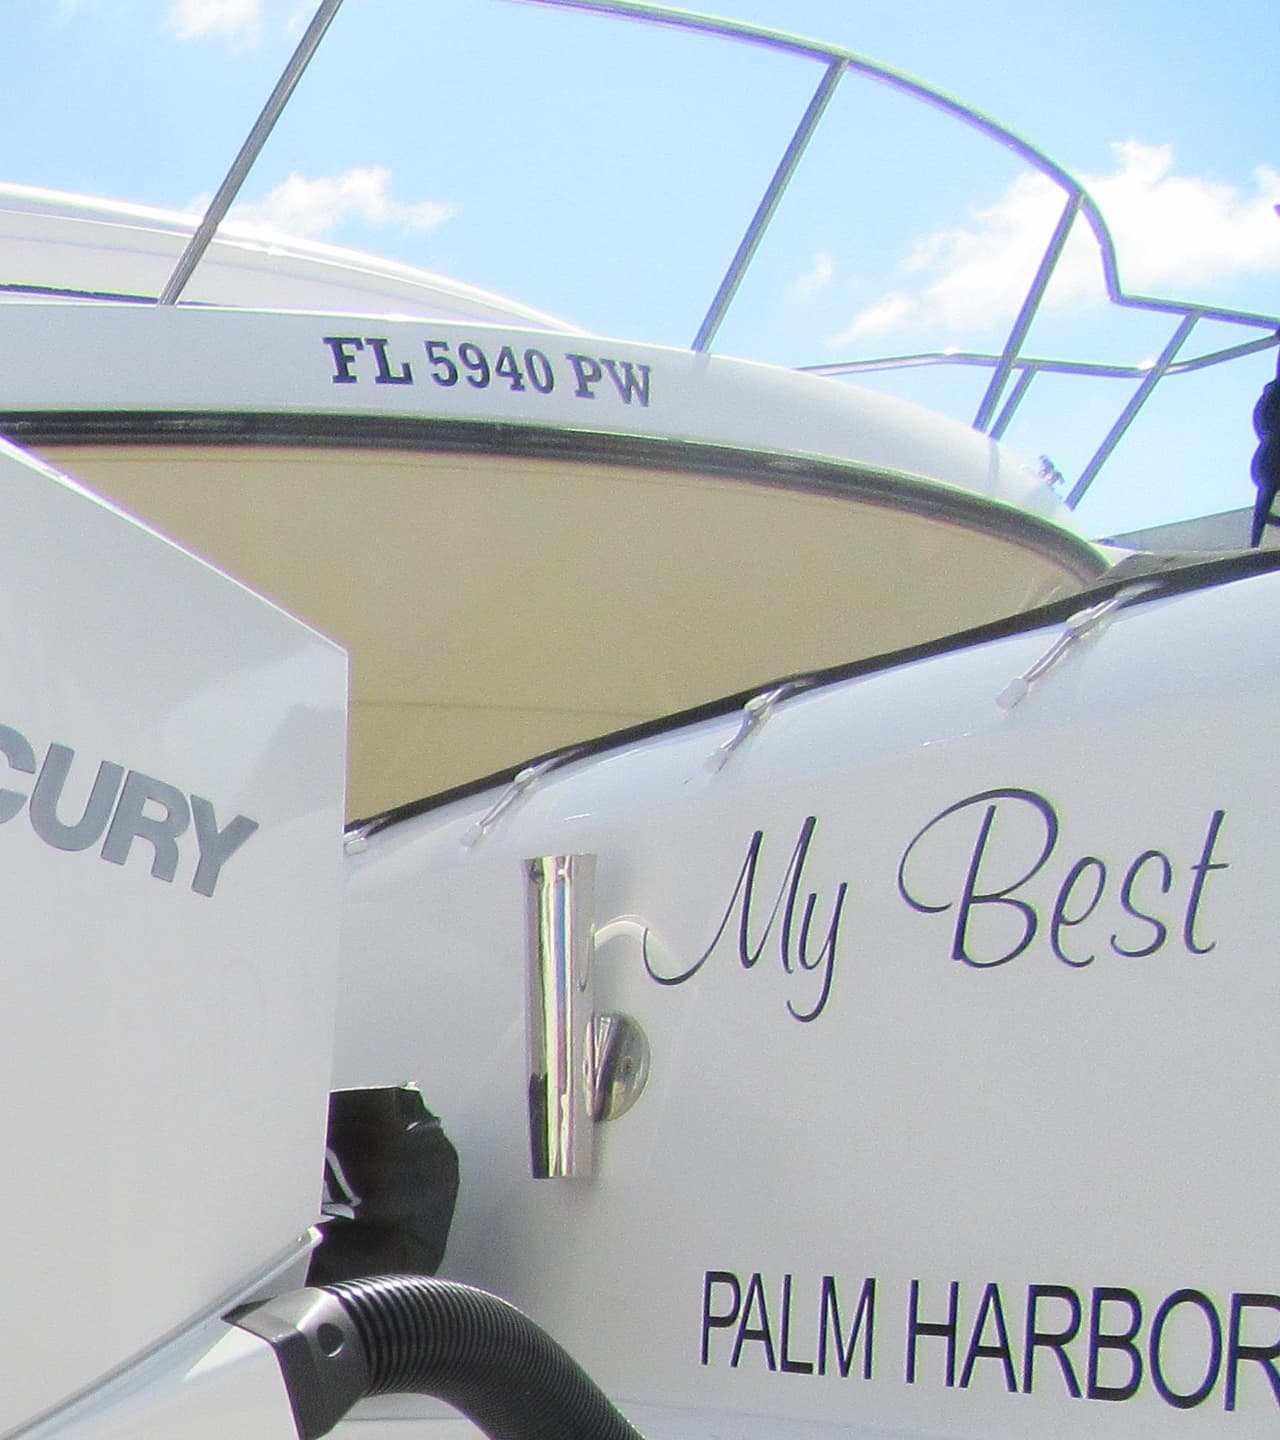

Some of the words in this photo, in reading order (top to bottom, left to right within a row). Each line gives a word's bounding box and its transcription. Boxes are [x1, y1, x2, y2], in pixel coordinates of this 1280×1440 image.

[323, 336, 414, 386] FL
[424, 340, 555, 395] 5940
[565, 353, 652, 408] PW
[643, 815, 847, 1023] My
[897, 787, 1230, 968] Best
[700, 1270, 876, 1380] PALM
[905, 1279, 1280, 1411] HARBOR
